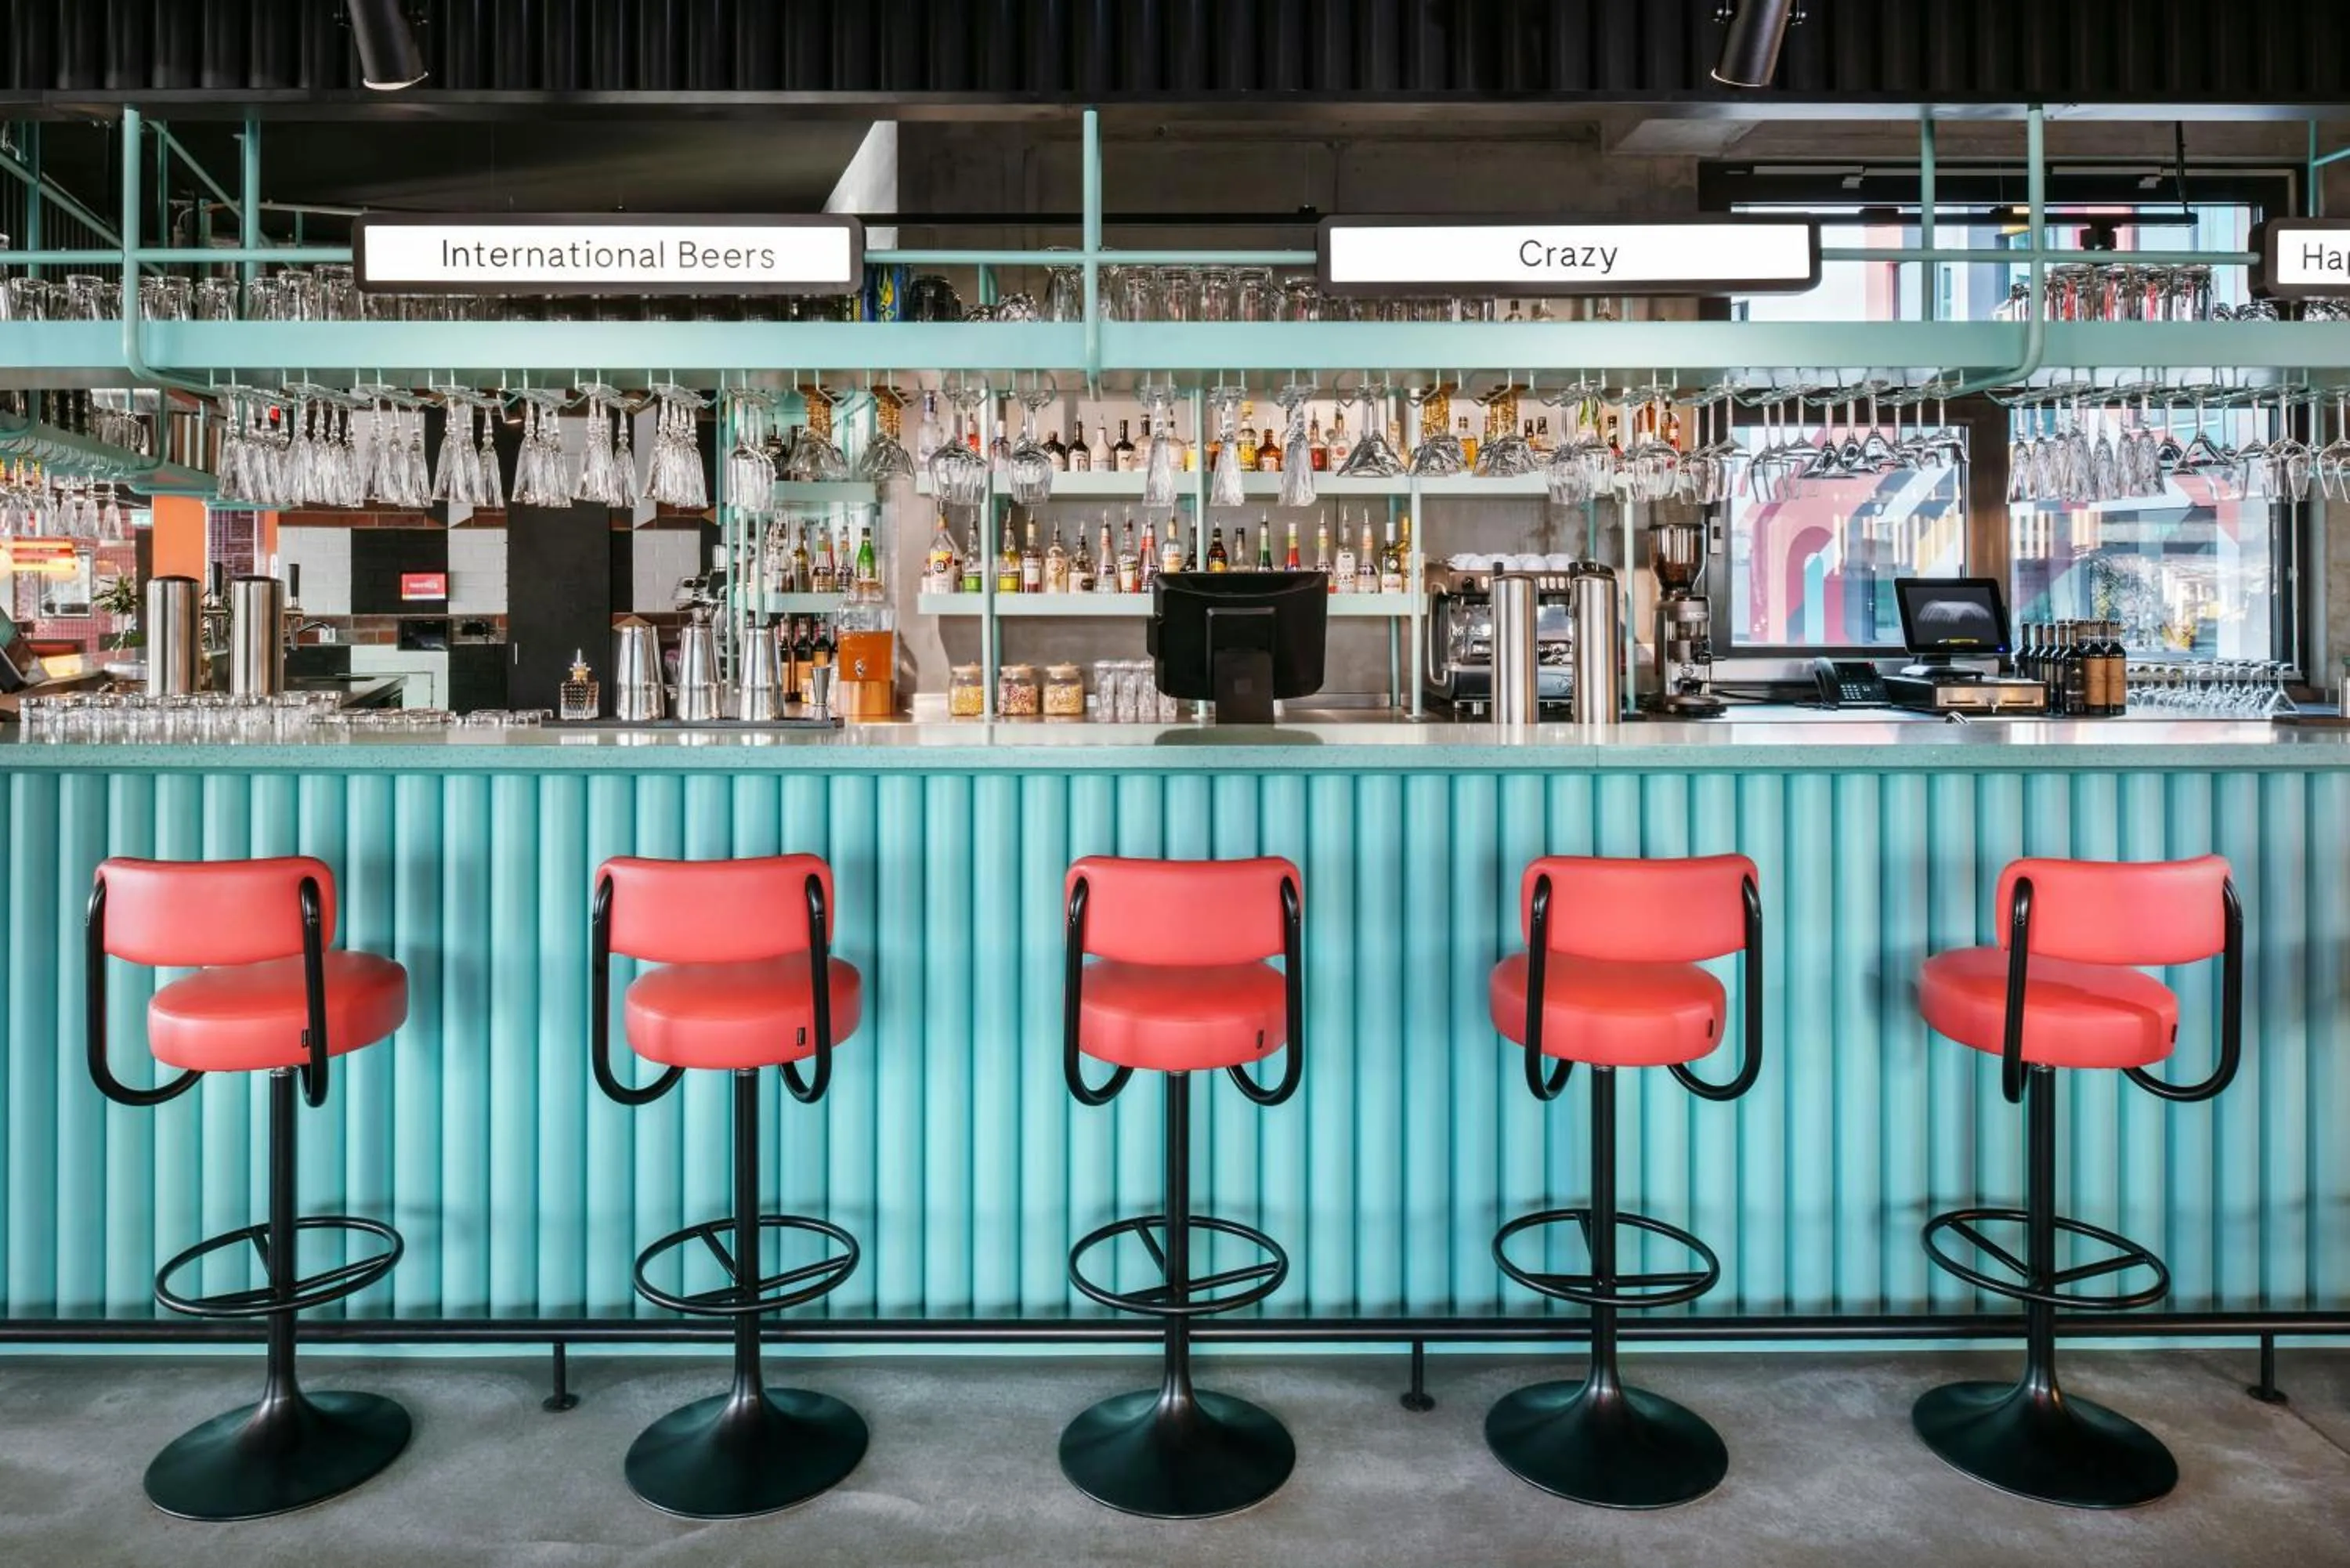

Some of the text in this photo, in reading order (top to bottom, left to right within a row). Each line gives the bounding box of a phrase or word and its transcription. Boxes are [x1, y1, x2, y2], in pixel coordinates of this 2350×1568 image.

[442, 239, 775, 269] International Beers
[1518, 238, 1618, 274] Crazy
[2302, 242, 2350, 277] Ha
